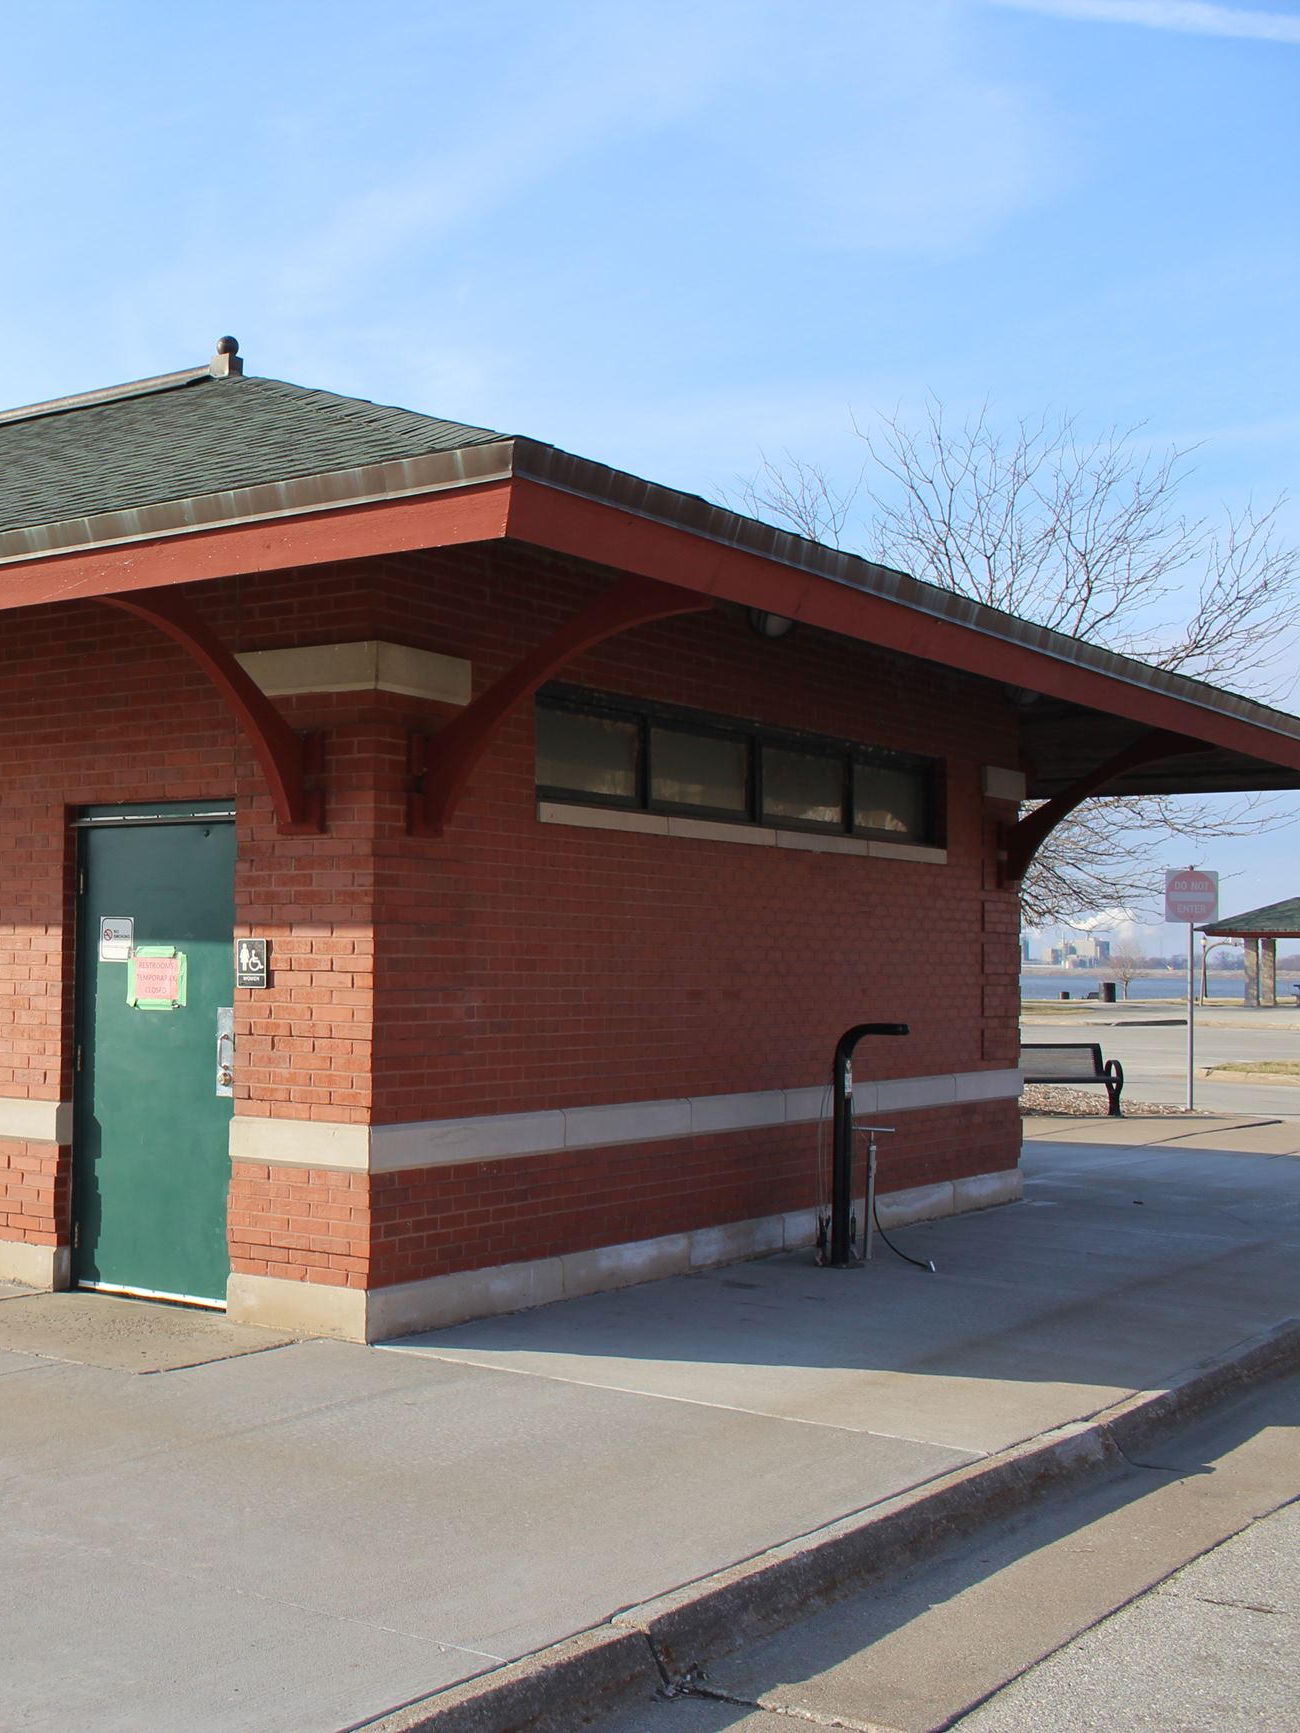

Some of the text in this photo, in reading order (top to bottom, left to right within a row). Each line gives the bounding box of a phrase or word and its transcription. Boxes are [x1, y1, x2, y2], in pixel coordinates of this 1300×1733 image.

[1174, 881, 1209, 890] DO NOT
[1177, 904, 1206, 913] ENTER
[139, 962, 174, 970] RESTROOMS
[137, 973, 178, 982] TEMPORARLY
[144, 986, 167, 994] CLOSED
